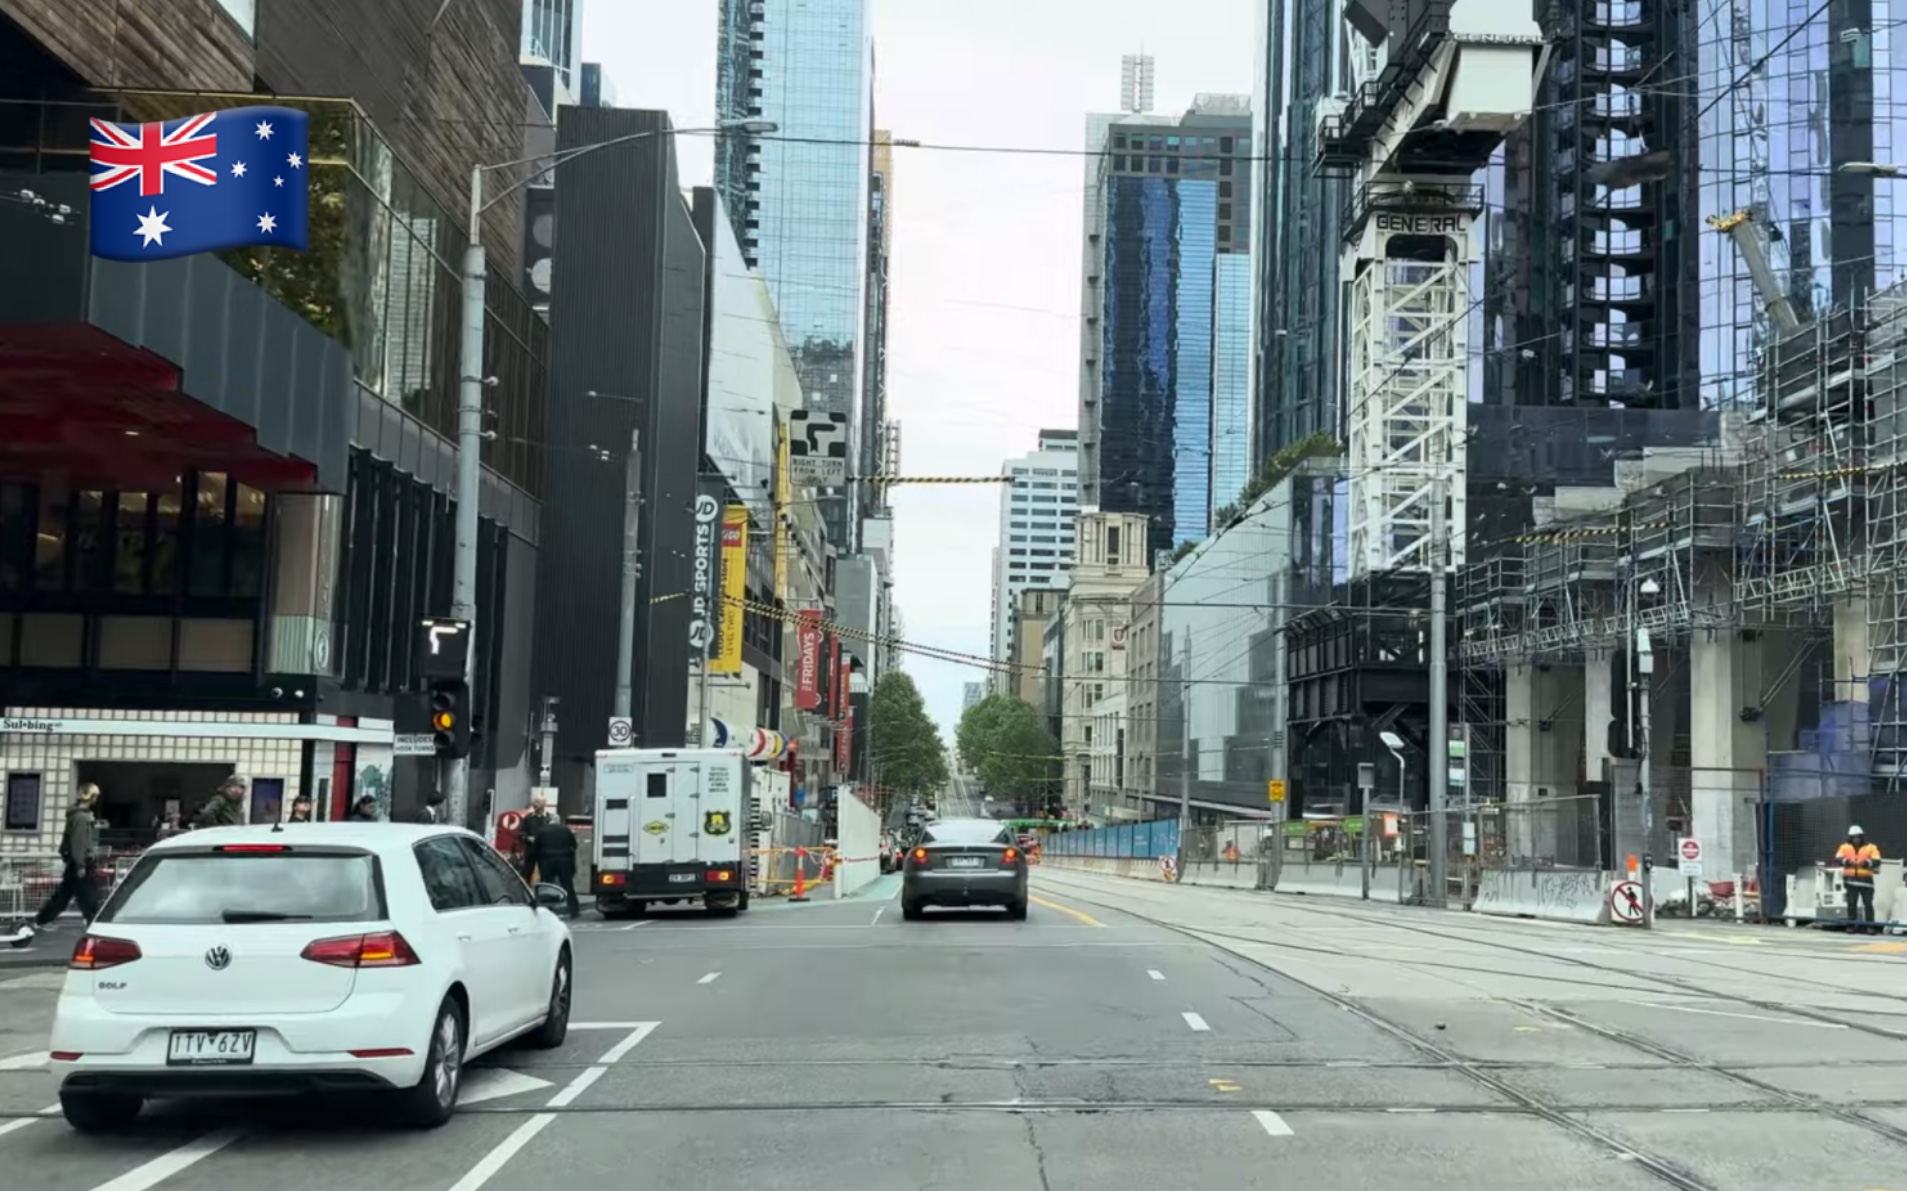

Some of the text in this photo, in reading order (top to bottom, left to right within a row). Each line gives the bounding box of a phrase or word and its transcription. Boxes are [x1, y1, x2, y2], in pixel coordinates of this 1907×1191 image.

[1453, 33, 1547, 44] GENERAL
[1376, 214, 1468, 232] GENERAL
[793, 458, 843, 468] RIGHT TURN
[794, 467, 841, 476] FROM LEFT
[693, 524, 709, 617] JD SPORTS
[727, 611, 736, 656] LEVEL TWO
[802, 632, 815, 685] FRIDAYS
[612, 725, 629, 737] 30
[397, 736, 432, 744] INCLUDES
